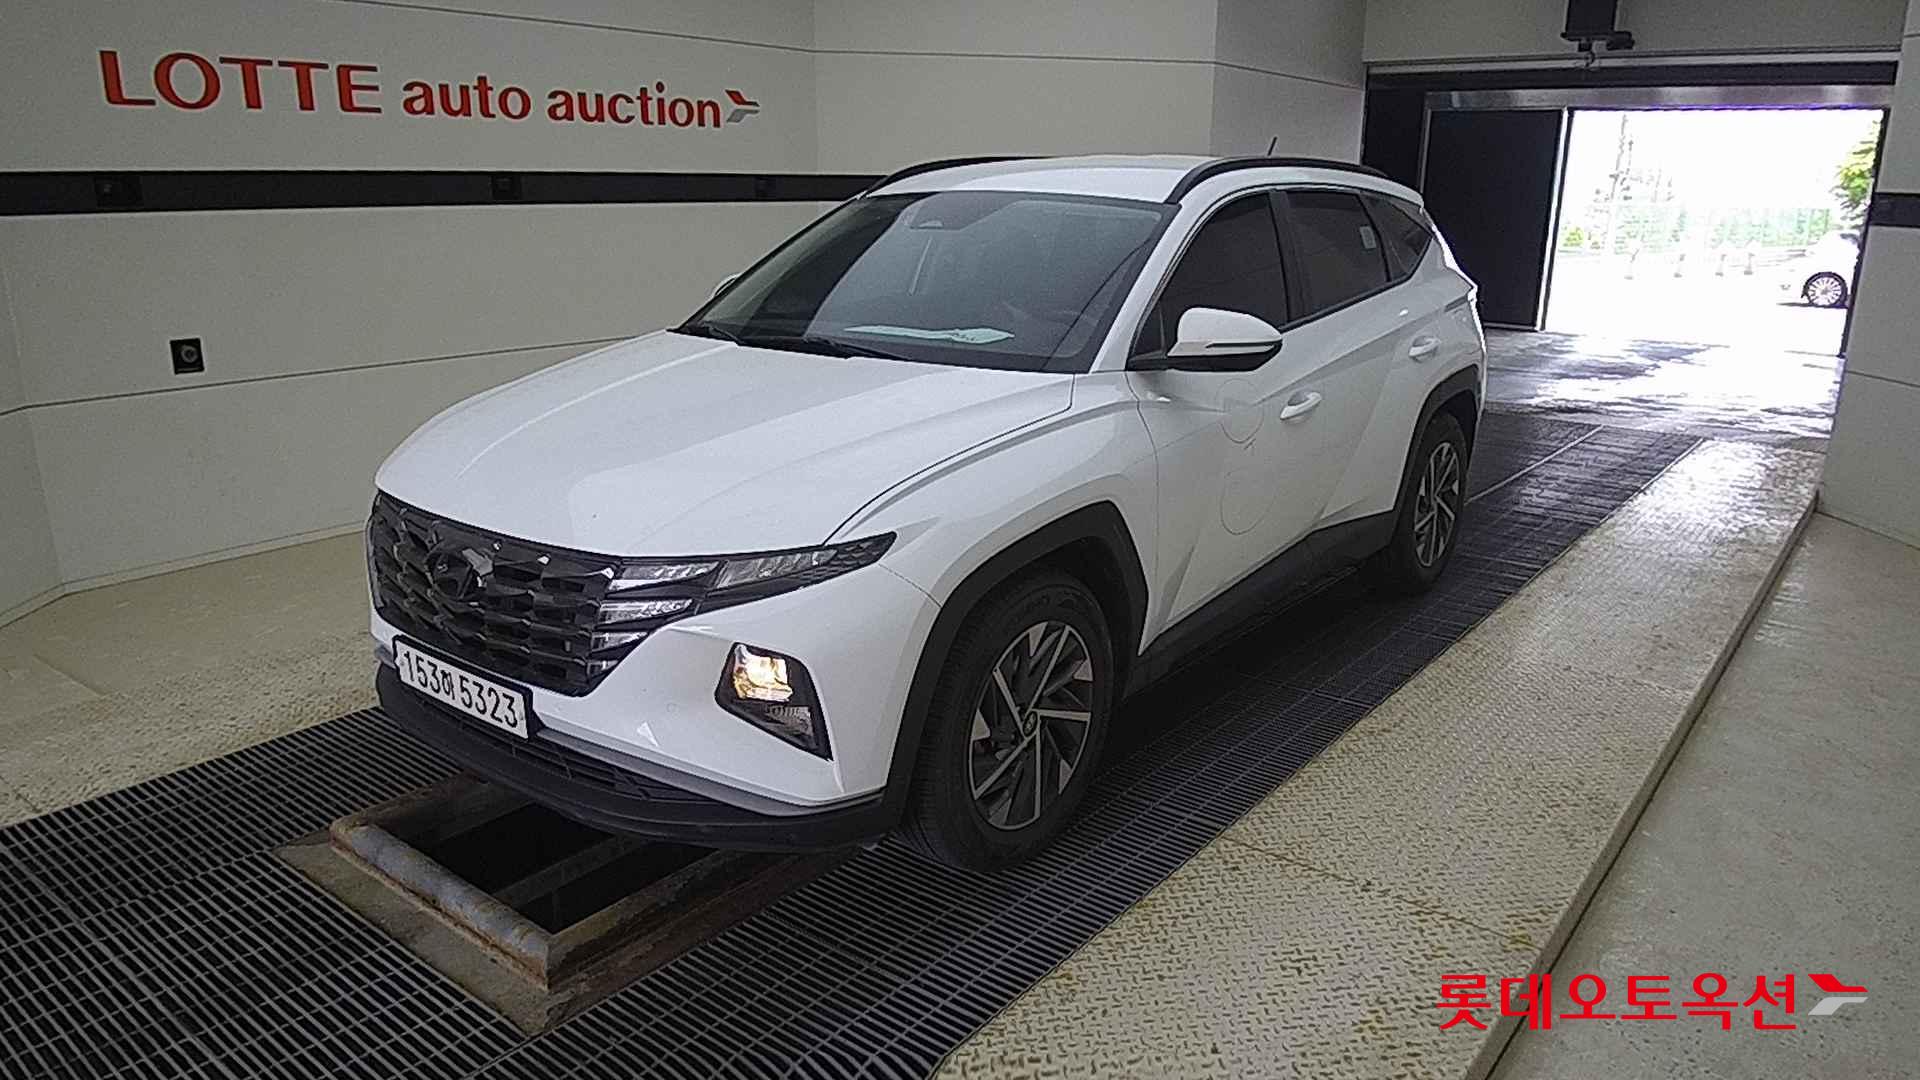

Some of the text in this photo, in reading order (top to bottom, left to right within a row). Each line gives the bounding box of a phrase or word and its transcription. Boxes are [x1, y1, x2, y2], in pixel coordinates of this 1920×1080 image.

[99, 50, 721, 128] LOTTE auto auction
[459, 675, 518, 728] 5323
